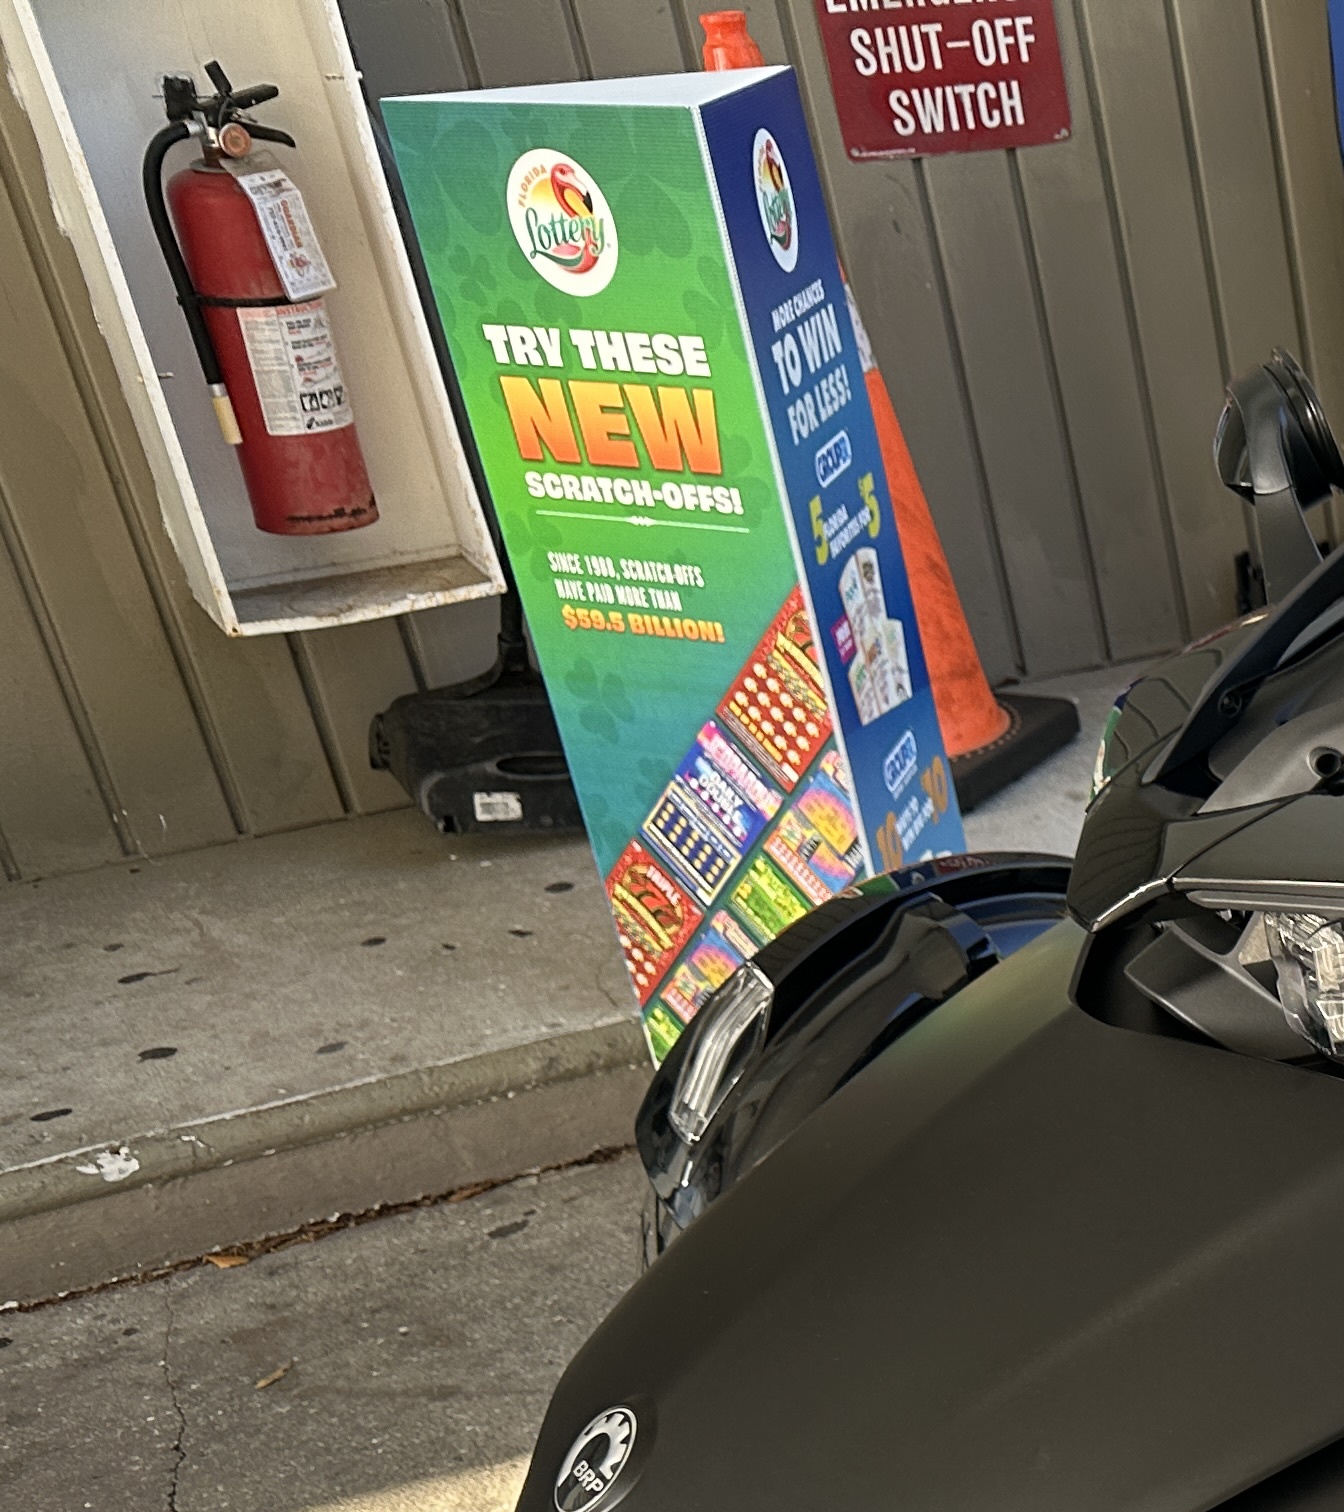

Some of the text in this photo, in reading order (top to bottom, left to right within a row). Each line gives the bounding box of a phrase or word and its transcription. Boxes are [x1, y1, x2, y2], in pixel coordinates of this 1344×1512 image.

[850, 16, 1035, 77] SHUT-OFF
[888, 80, 1025, 137] SWITCH
[517, 163, 548, 208] FLORIDA
[525, 206, 605, 260] Lottery
[482, 323, 712, 377] TRY THESE
[771, 303, 843, 396] TO WIN
[499, 375, 722, 475] NEW
[786, 363, 852, 447] FOR LESS!
[524, 471, 745, 515] SCRATCH-OFFS!
[808, 494, 829, 566] 5
[547, 551, 584, 575] SINCE
[619, 558, 705, 588] SCRATCH-OFFS
[554, 578, 683, 612] HAVE PAID MORE THAN
[561, 603, 726, 643] $59.5 BILLION!
[646, 864, 682, 906] TRIPLE
[572, 1459, 605, 1492] BRP
